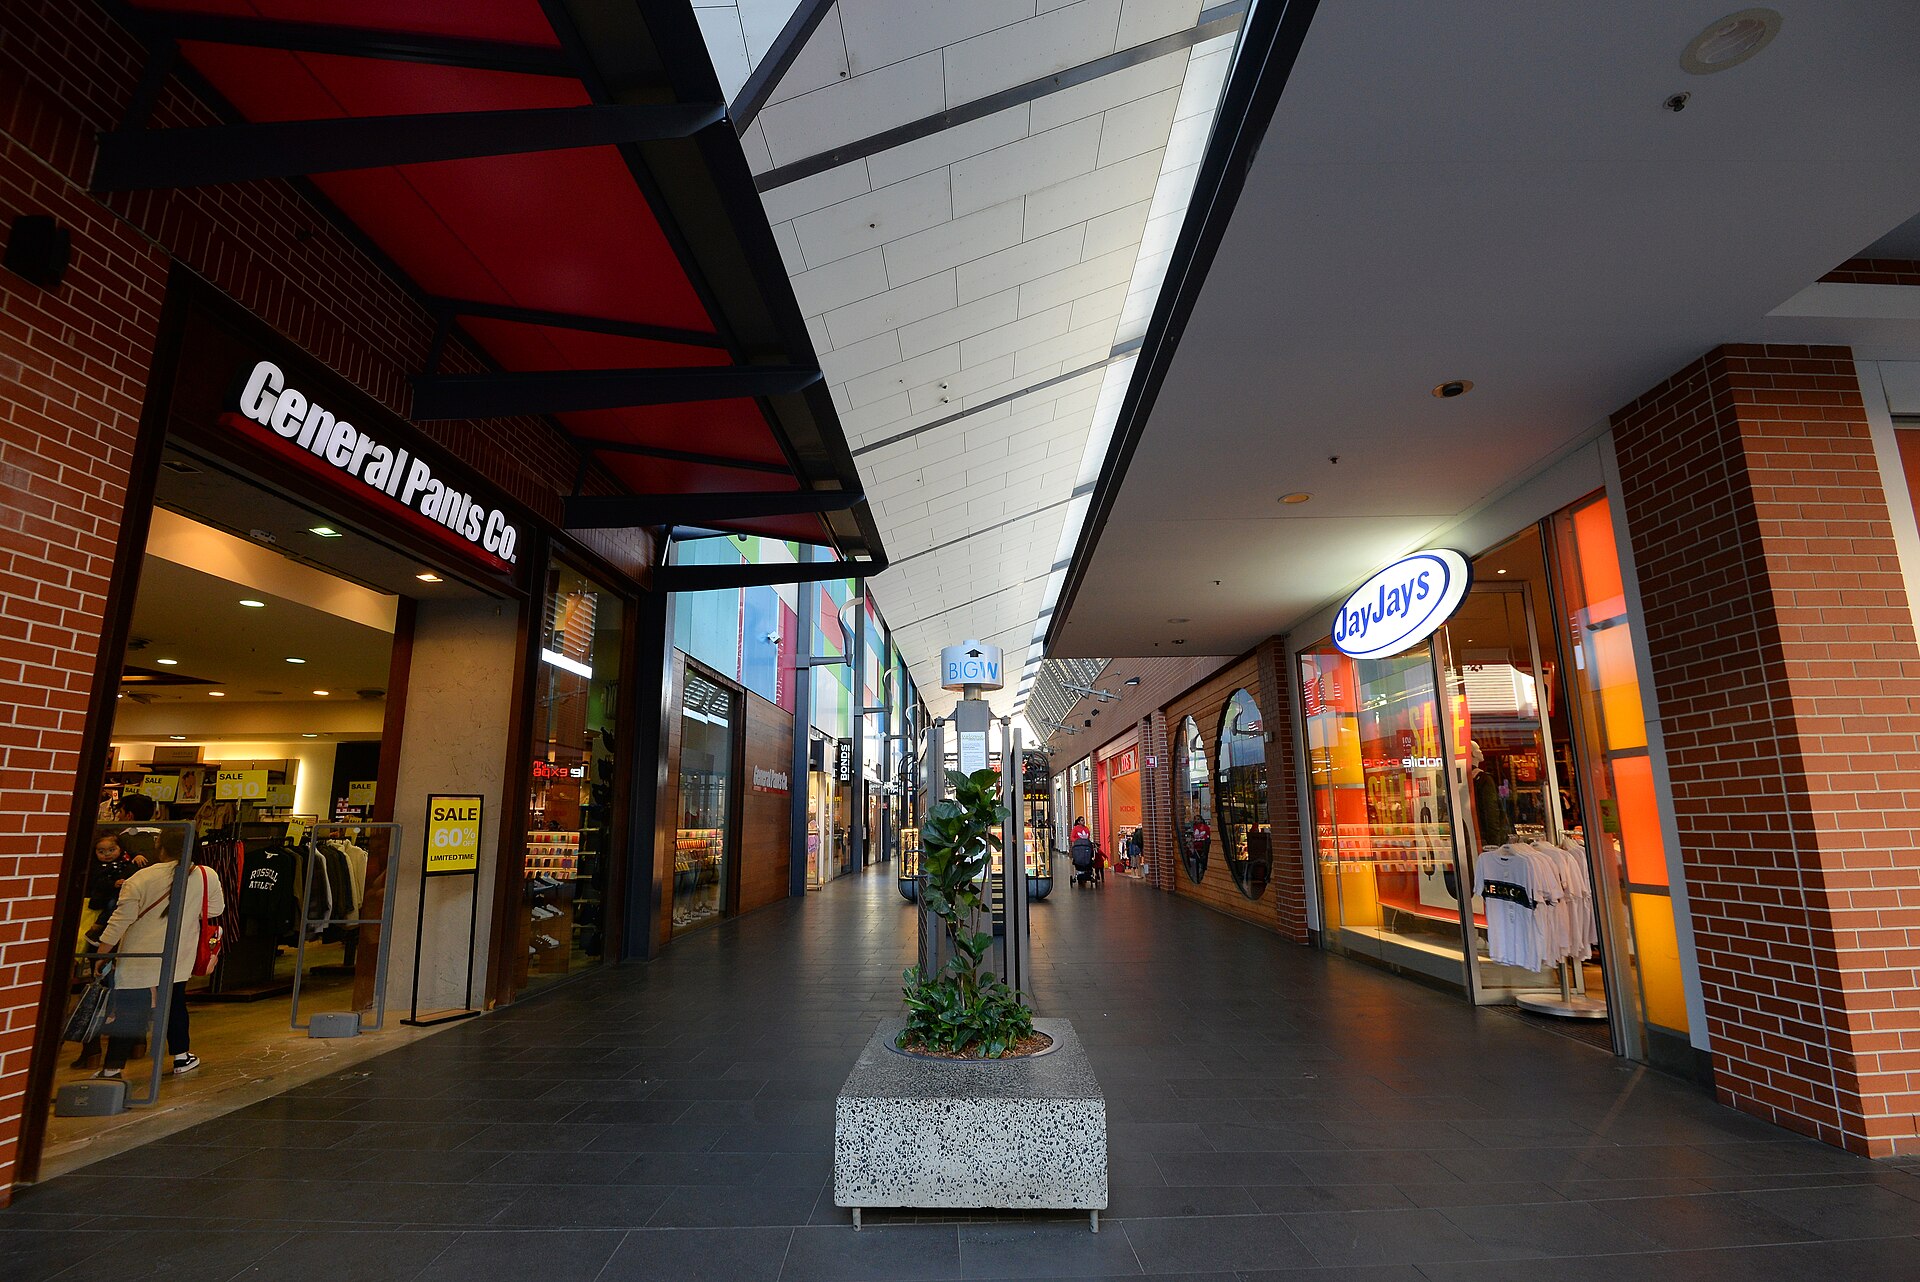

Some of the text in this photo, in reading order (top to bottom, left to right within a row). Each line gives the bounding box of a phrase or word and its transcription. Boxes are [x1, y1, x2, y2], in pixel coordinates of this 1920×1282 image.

[240, 361, 517, 564] General Pants Co.
[1409, 695, 1466, 758] SAE
[841, 744, 849, 781] BONDS
[125, 786, 140, 795] SALE
[221, 781, 260, 797] $10
[433, 807, 478, 822] SALE
[1120, 805, 1136, 813] KIDS
[430, 854, 458, 862] LIMITED
